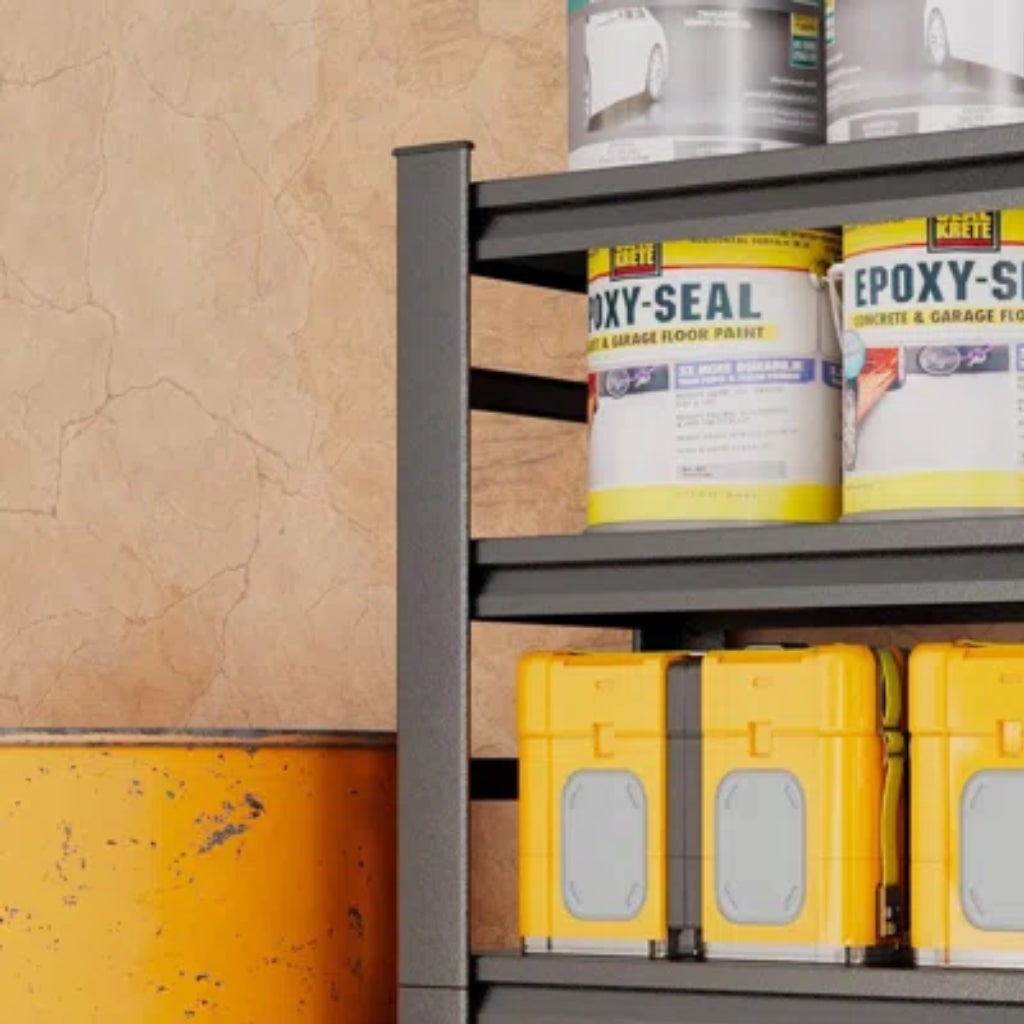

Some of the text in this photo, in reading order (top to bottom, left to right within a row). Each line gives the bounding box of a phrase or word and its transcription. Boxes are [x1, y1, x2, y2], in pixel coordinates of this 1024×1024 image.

[588, 283, 762, 332] OXY-SEAL
[914, 309, 925, 324] &
[931, 309, 994, 324] GARAGE
[612, 331, 656, 349] GARAGE
[662, 329, 709, 344] FLOOR
[714, 327, 764, 340] PAINT
